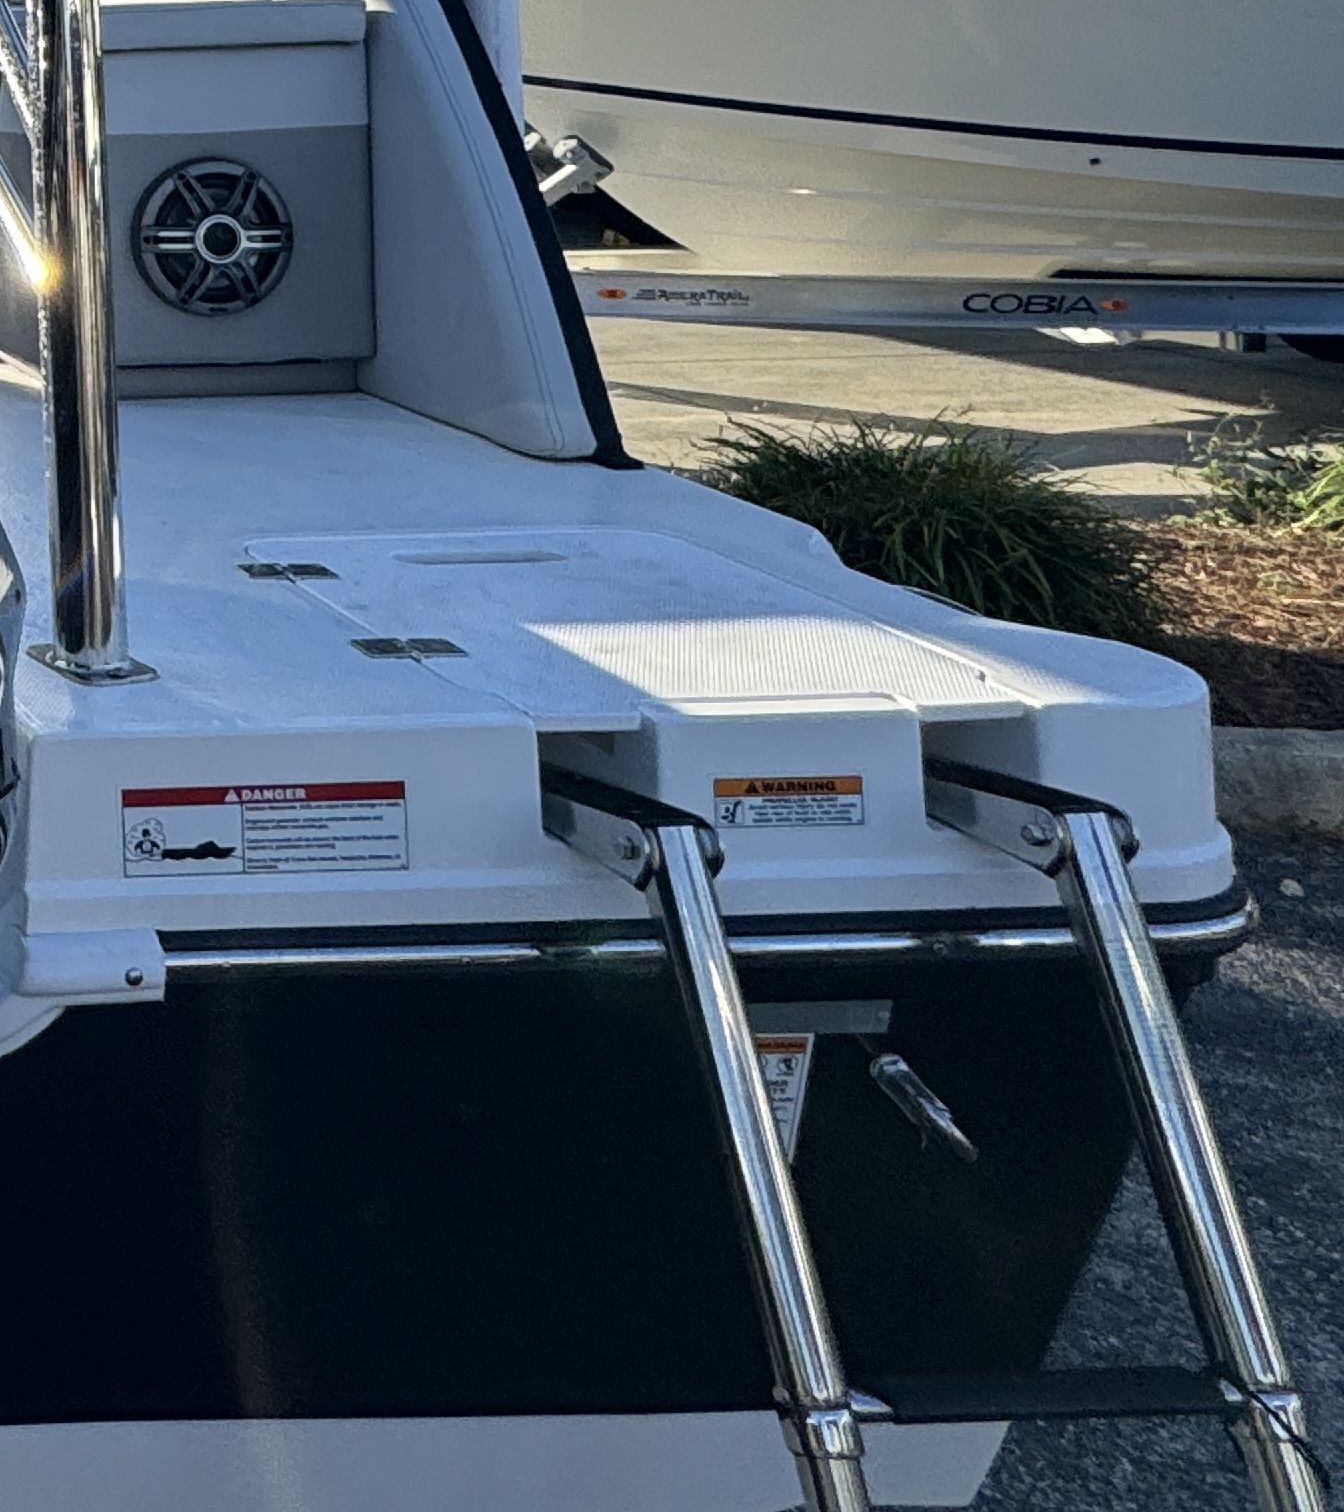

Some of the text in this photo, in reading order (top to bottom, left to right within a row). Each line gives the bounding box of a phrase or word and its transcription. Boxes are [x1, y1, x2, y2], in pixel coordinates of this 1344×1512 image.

[963, 293, 1099, 315] COBIA
[763, 781, 836, 792] WARNING
[240, 788, 307, 801] DANGER
